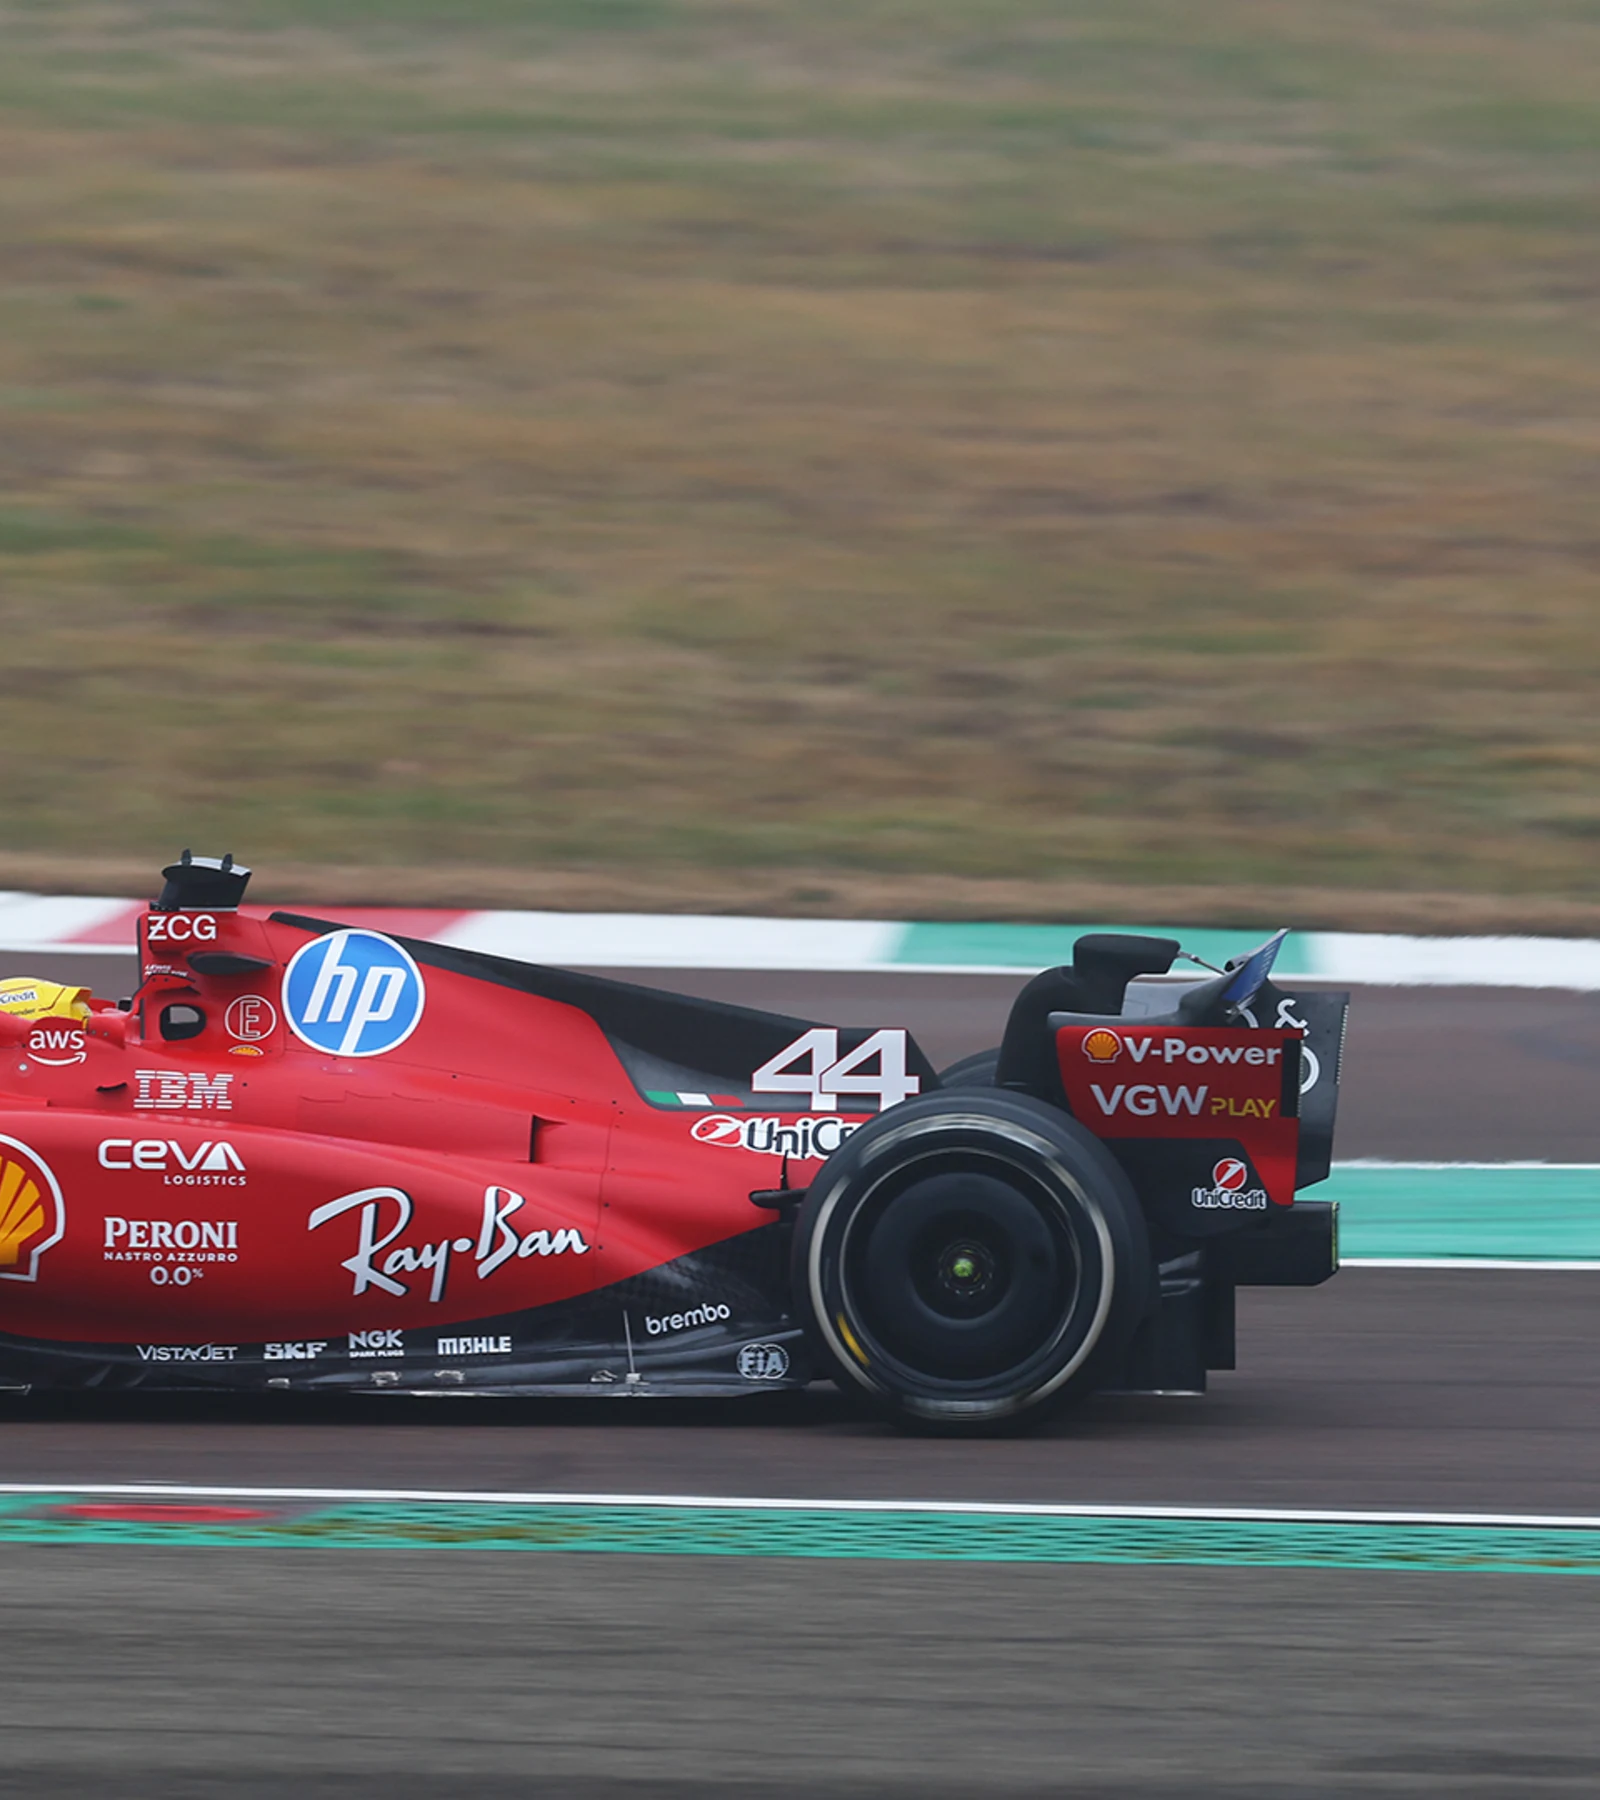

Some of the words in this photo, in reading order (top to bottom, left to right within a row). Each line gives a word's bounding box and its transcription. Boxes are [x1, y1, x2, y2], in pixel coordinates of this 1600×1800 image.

[300, 931, 408, 1055] hp
[28, 1029, 86, 1050] aws
[1123, 1036, 1282, 1065] V-Power
[752, 1027, 920, 1113] 44
[133, 1069, 234, 1110] IBM
[1089, 1083, 1209, 1116] VGW
[1210, 1097, 1277, 1119] PLAY
[163, 1174, 248, 1187] LOGISTICS
[1192, 1187, 1267, 1210] UniCredit
[103, 1216, 238, 1249] PERONI
[103, 1251, 163, 1262] NASTRO
[166, 1252, 239, 1263] AZZURRO
[149, 1265, 204, 1286] 0.0%
[645, 1302, 731, 1335] brembo
[348, 1329, 404, 1349] NGK
[437, 1335, 512, 1355] MAHLE
[263, 1341, 328, 1360] SKF
[349, 1350, 376, 1359] SPARK
[377, 1349, 405, 1358] PLUGS
